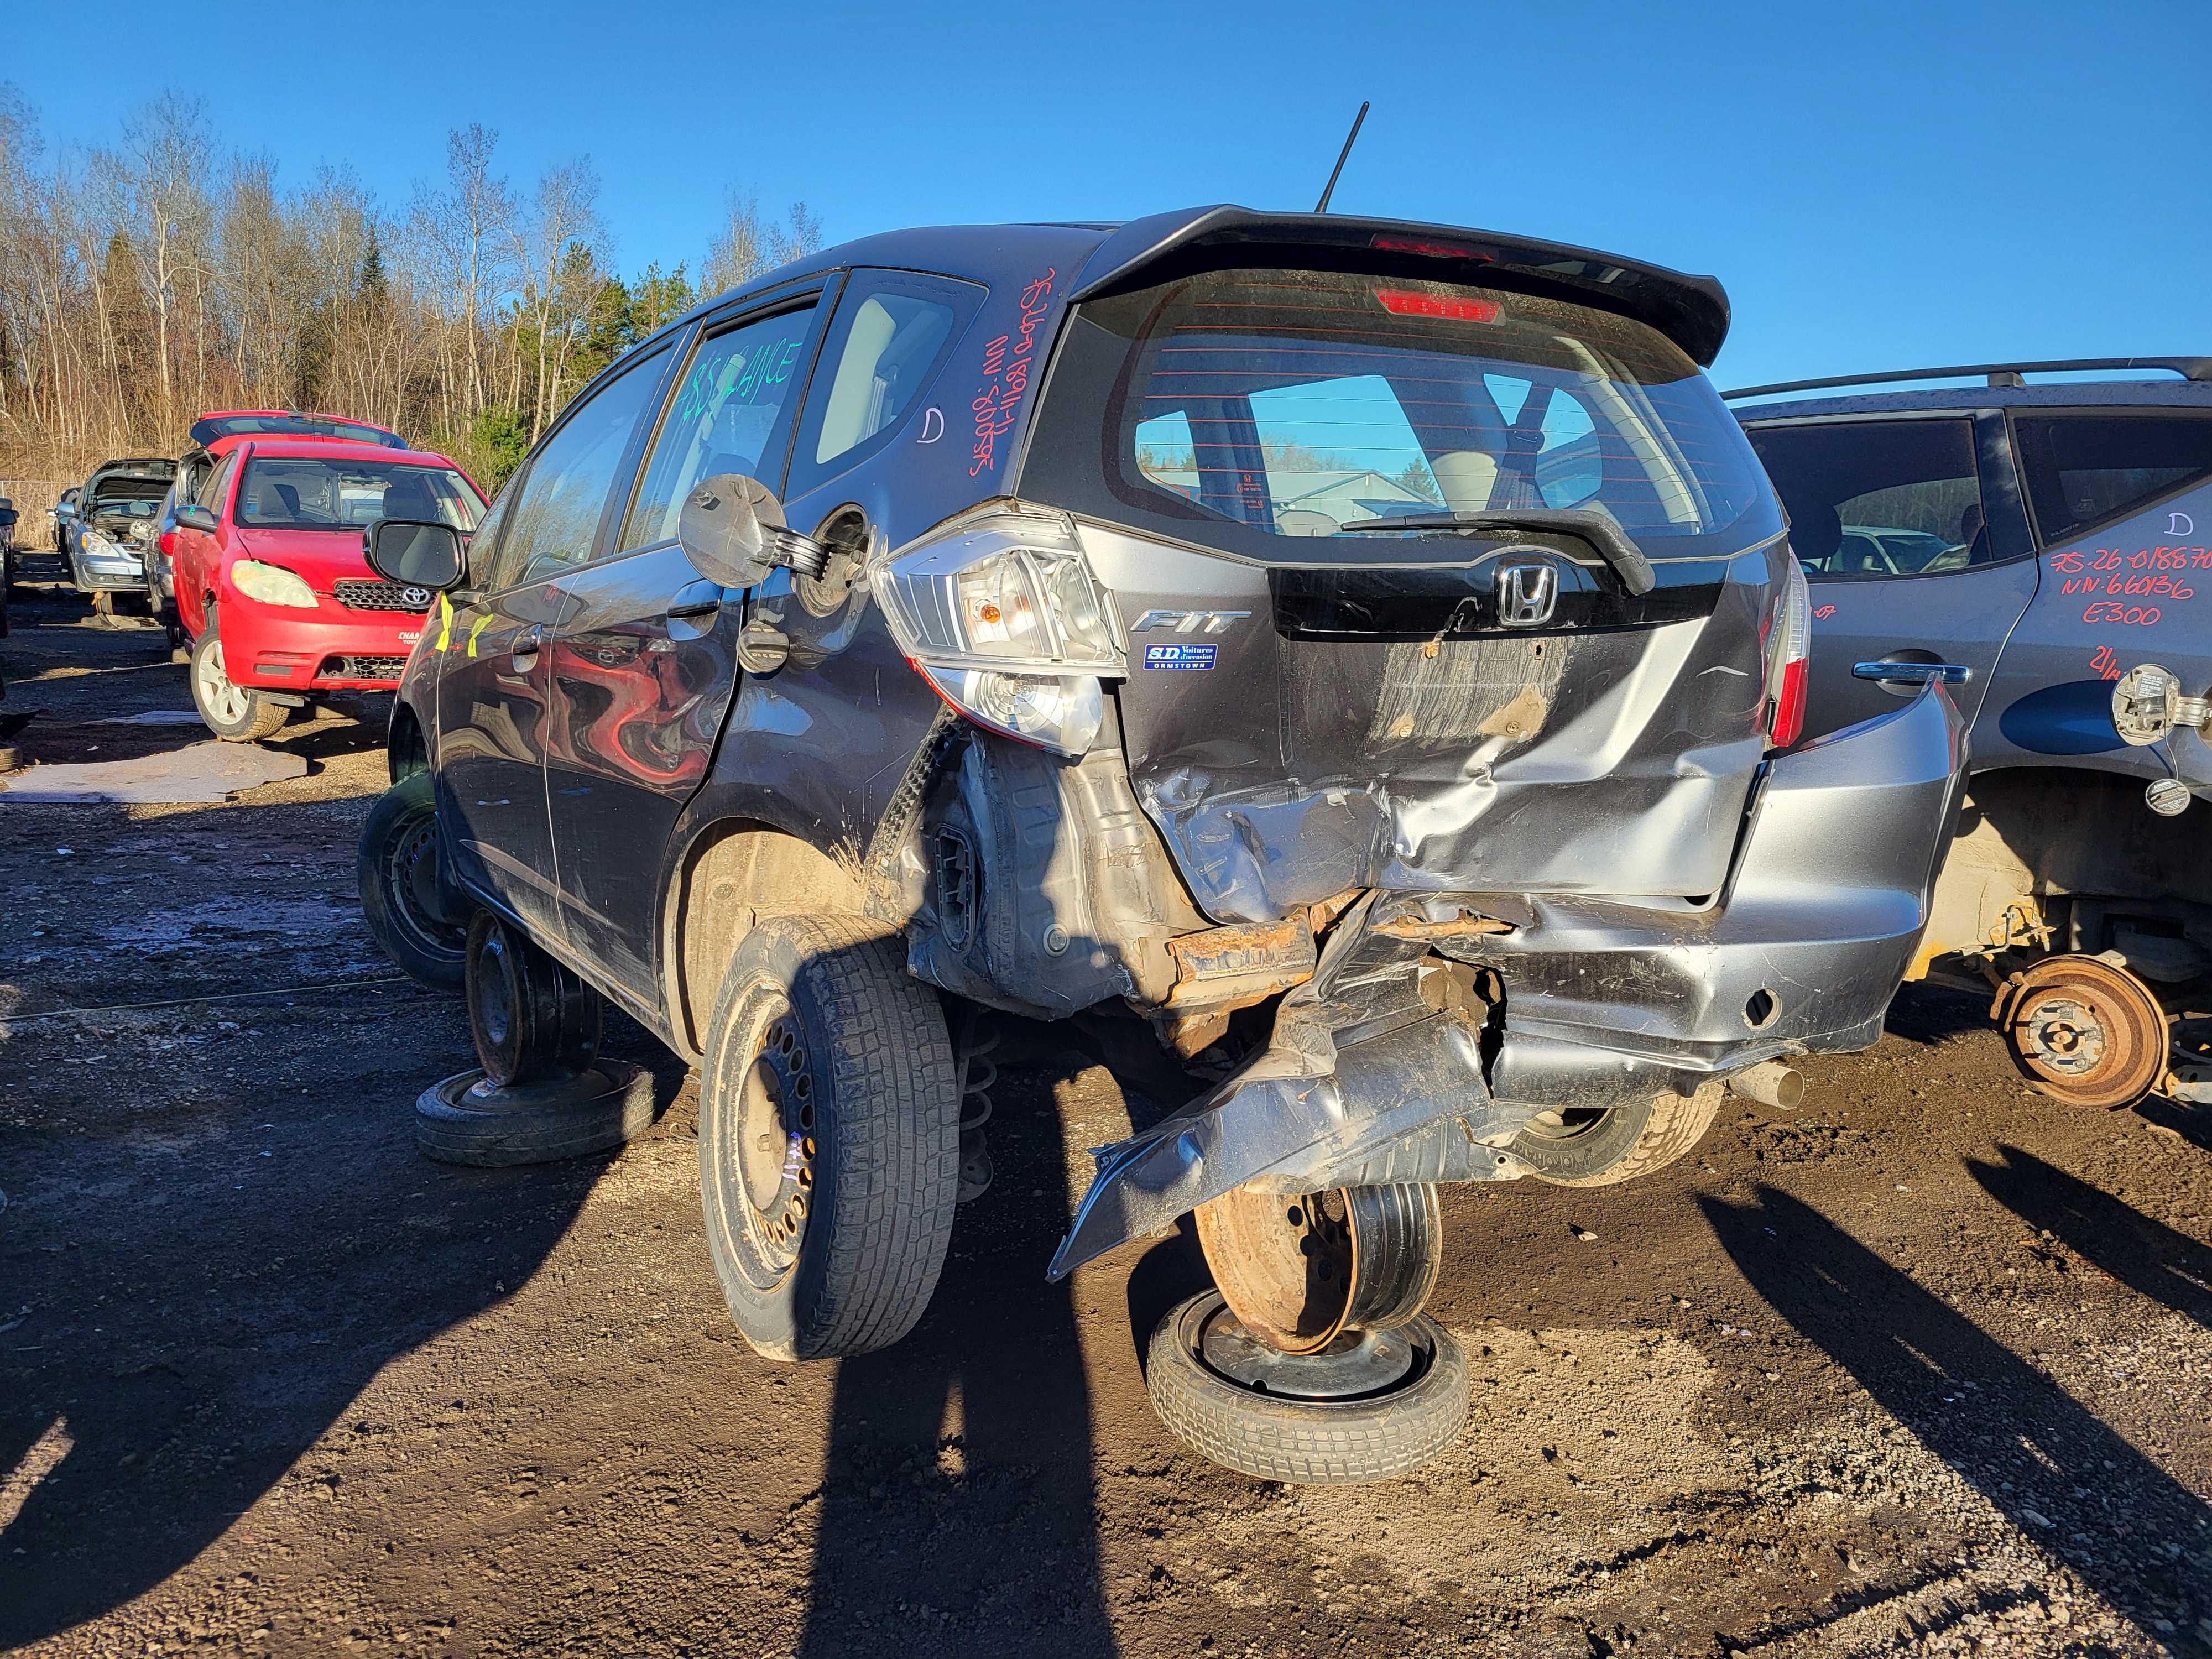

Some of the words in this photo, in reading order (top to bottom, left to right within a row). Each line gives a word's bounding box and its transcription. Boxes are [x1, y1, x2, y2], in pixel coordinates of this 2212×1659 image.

[916, 408, 945, 444] D
[2164, 512, 2194, 536] D
[2083, 602, 2162, 626] E300
[1148, 647, 1180, 660] S.D.
